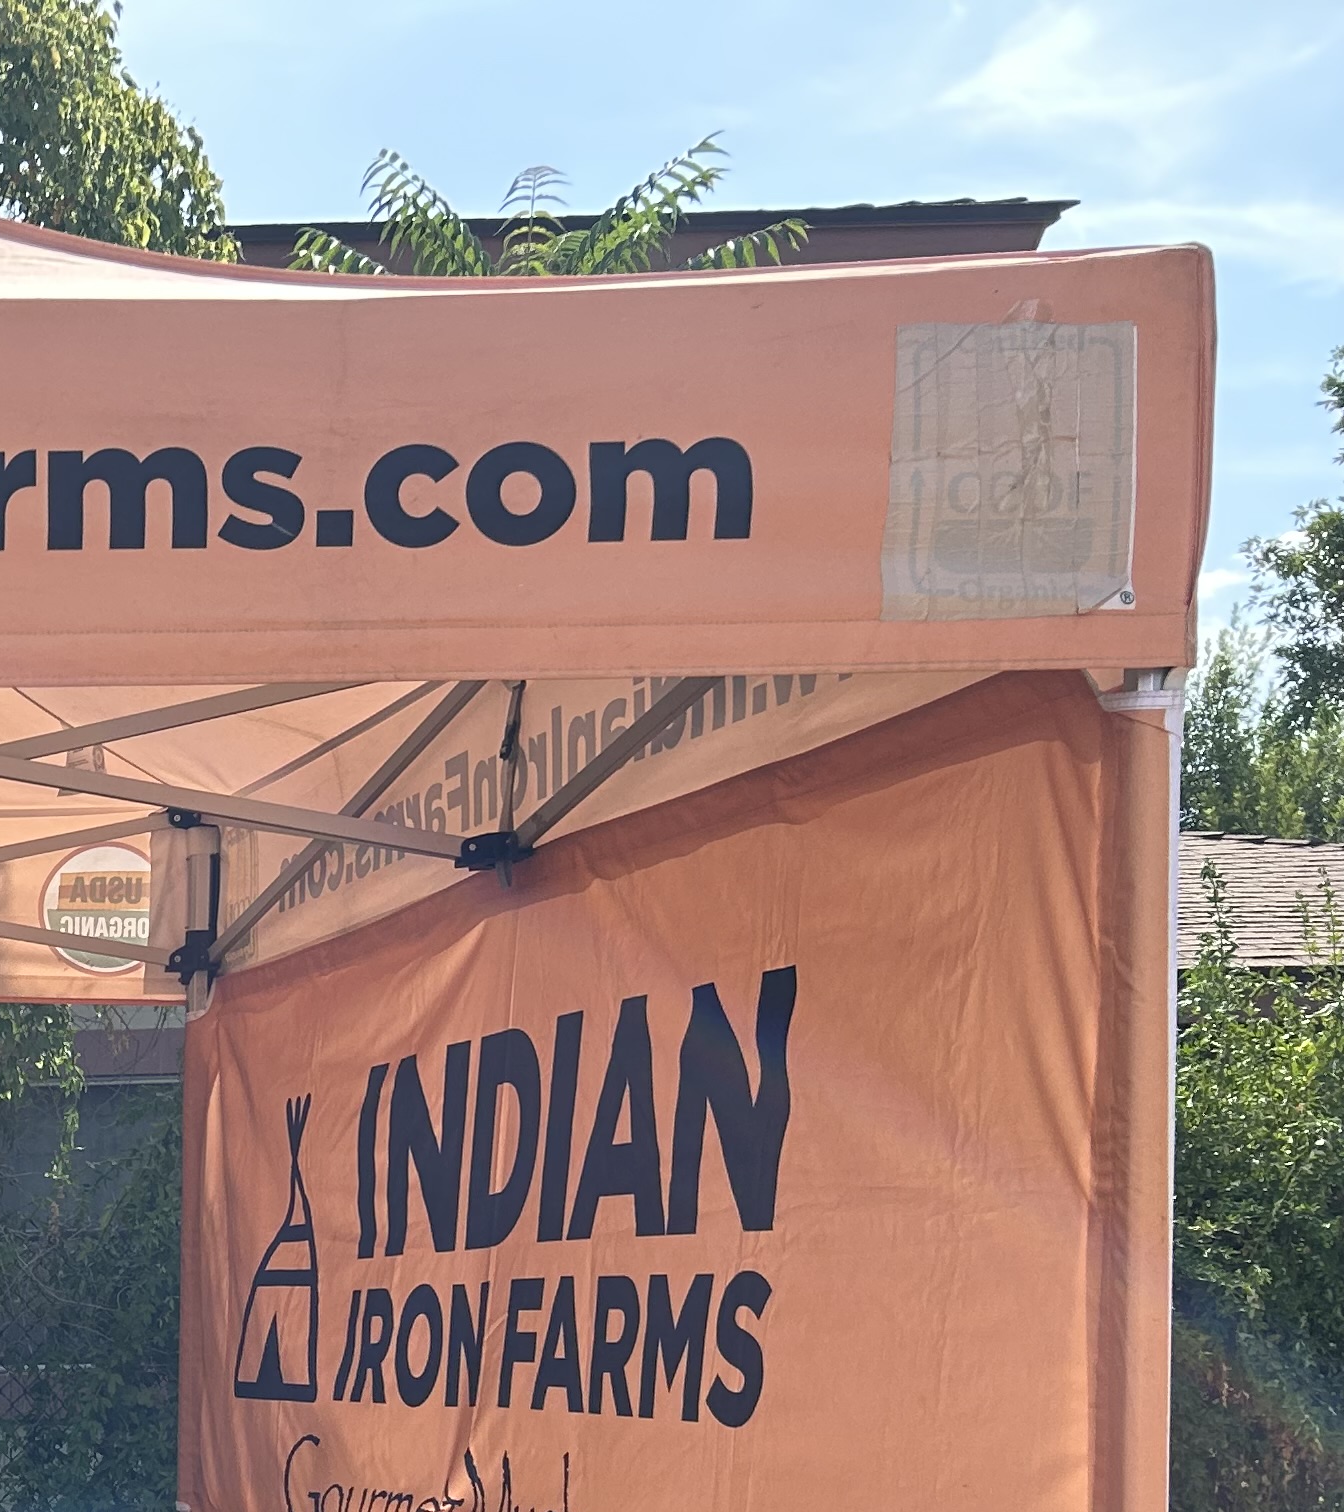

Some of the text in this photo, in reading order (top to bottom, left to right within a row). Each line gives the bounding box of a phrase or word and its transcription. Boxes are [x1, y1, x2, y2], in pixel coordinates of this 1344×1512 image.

[358, 965, 797, 1260] INDIAN
[333, 1270, 773, 1427] IRON FARMS
